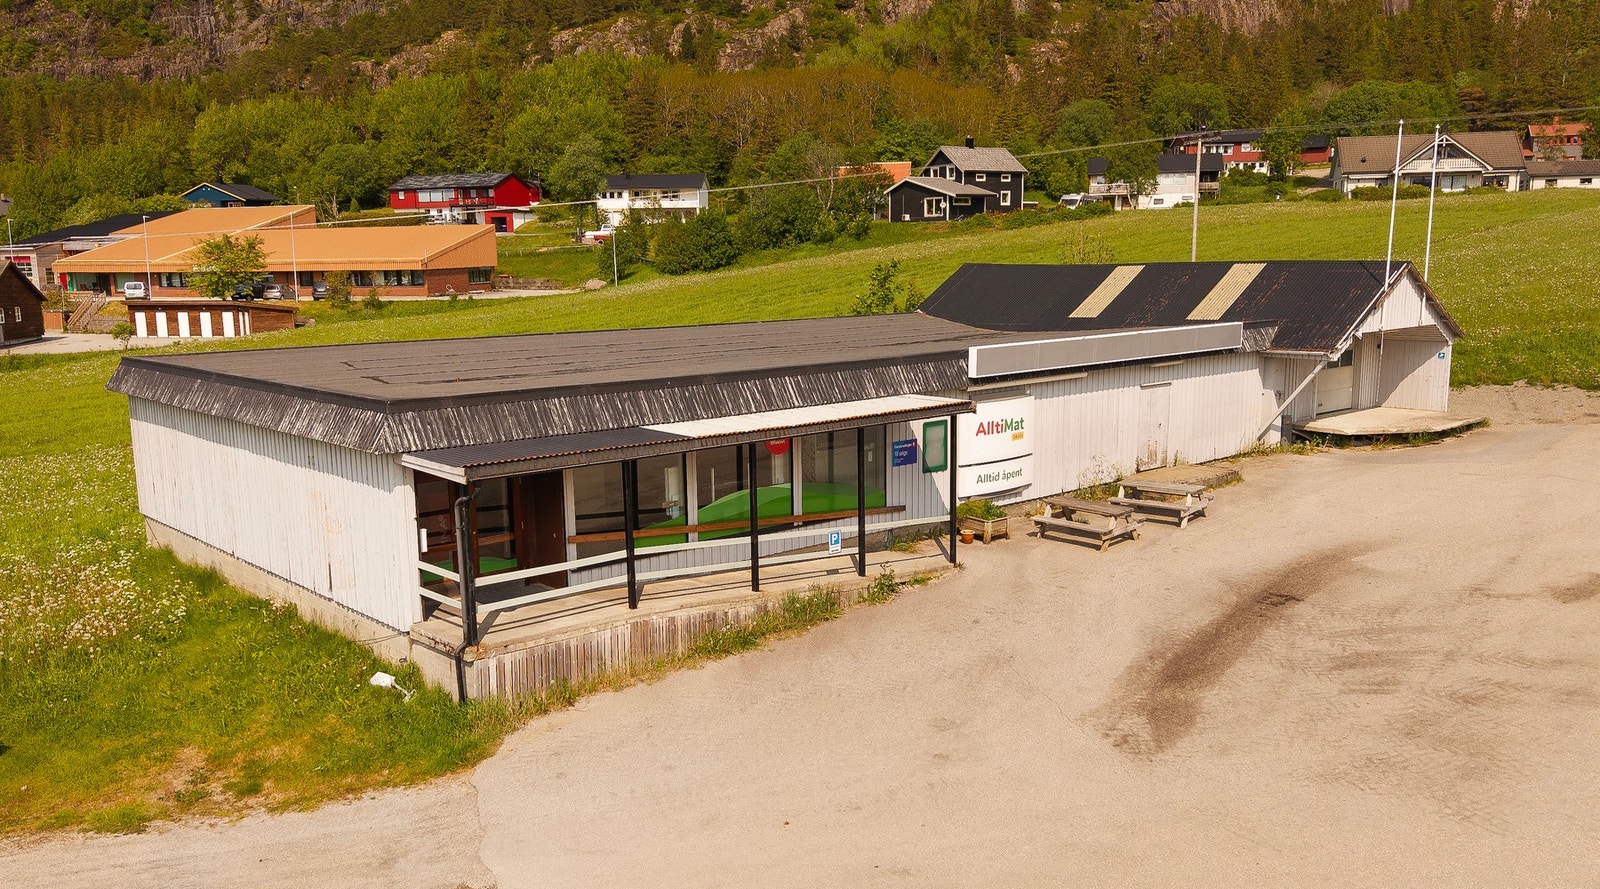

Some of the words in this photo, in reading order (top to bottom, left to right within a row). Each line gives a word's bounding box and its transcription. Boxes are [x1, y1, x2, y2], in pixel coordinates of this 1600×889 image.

[976, 417, 1024, 436] AlltiMat
[976, 472, 1000, 484] Alltid
[1002, 468, 1022, 481] åpent
[832, 533, 838, 545] P
